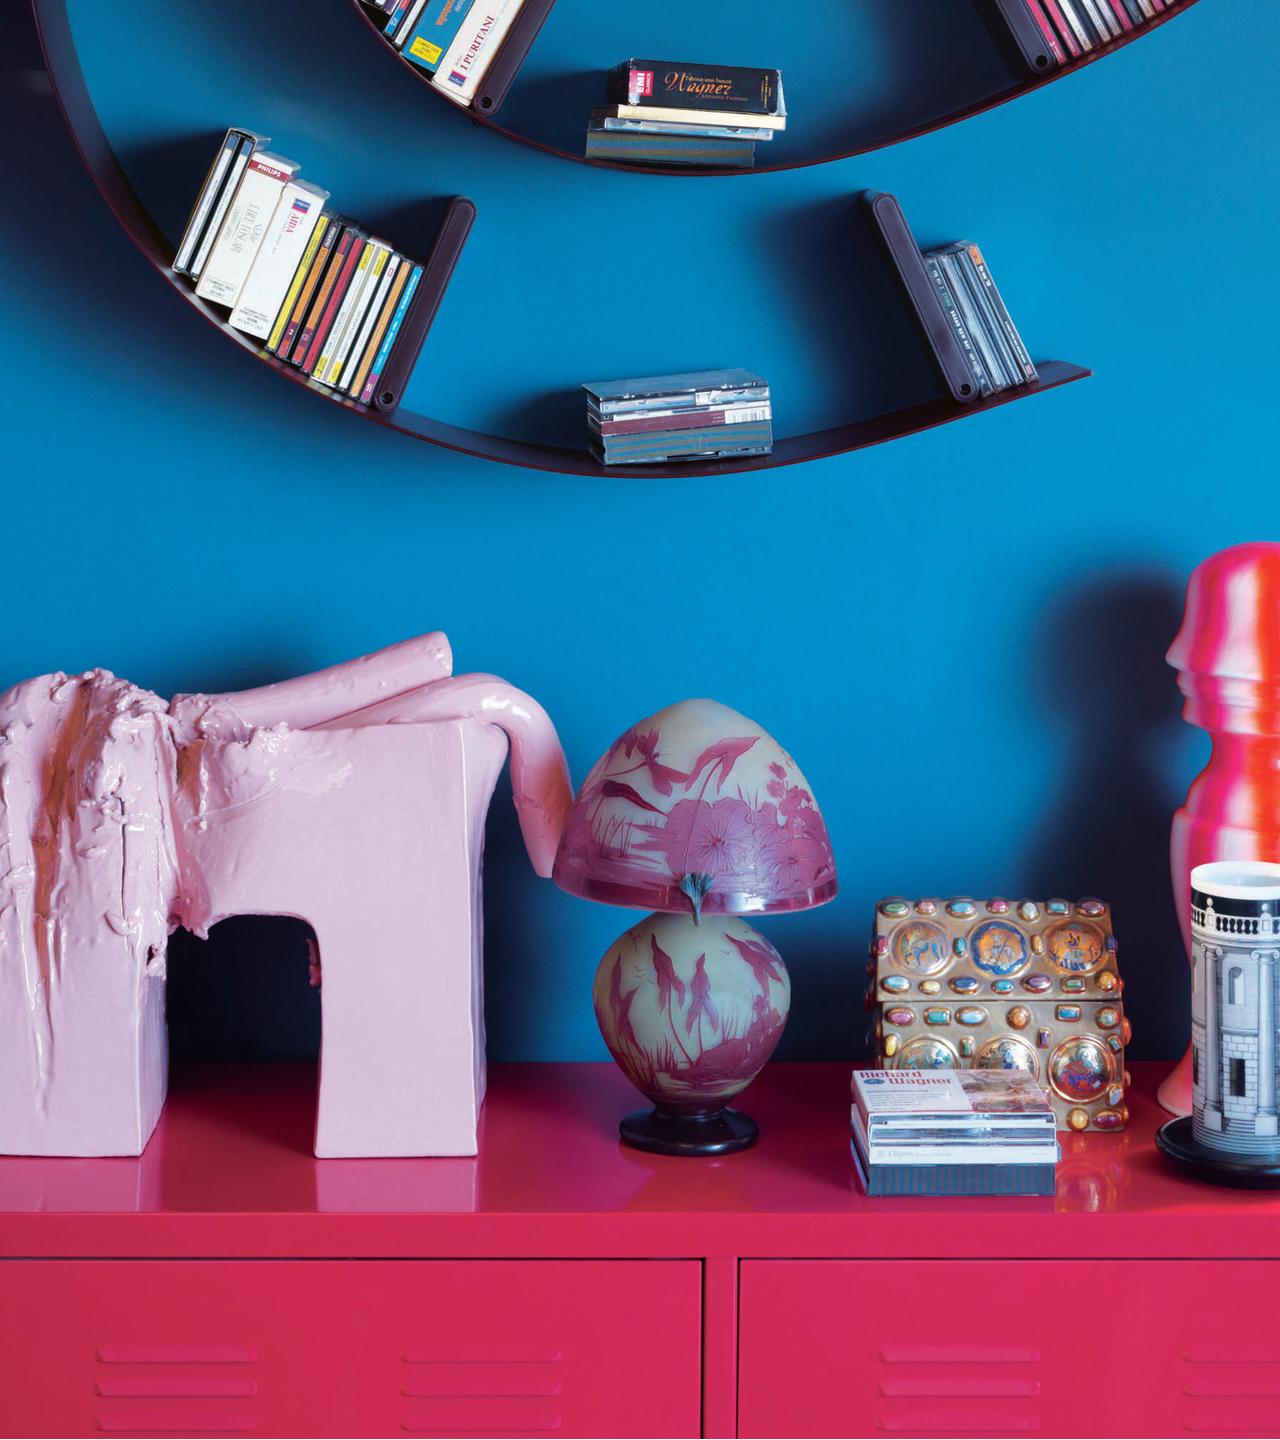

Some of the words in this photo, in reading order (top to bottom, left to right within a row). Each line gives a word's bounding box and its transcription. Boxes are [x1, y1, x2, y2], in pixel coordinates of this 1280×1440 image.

[462, 13, 494, 65] PURITANI
[637, 73, 646, 93] EMI
[664, 71, 732, 96] Wagner
[257, 162, 281, 177] PHILIPS
